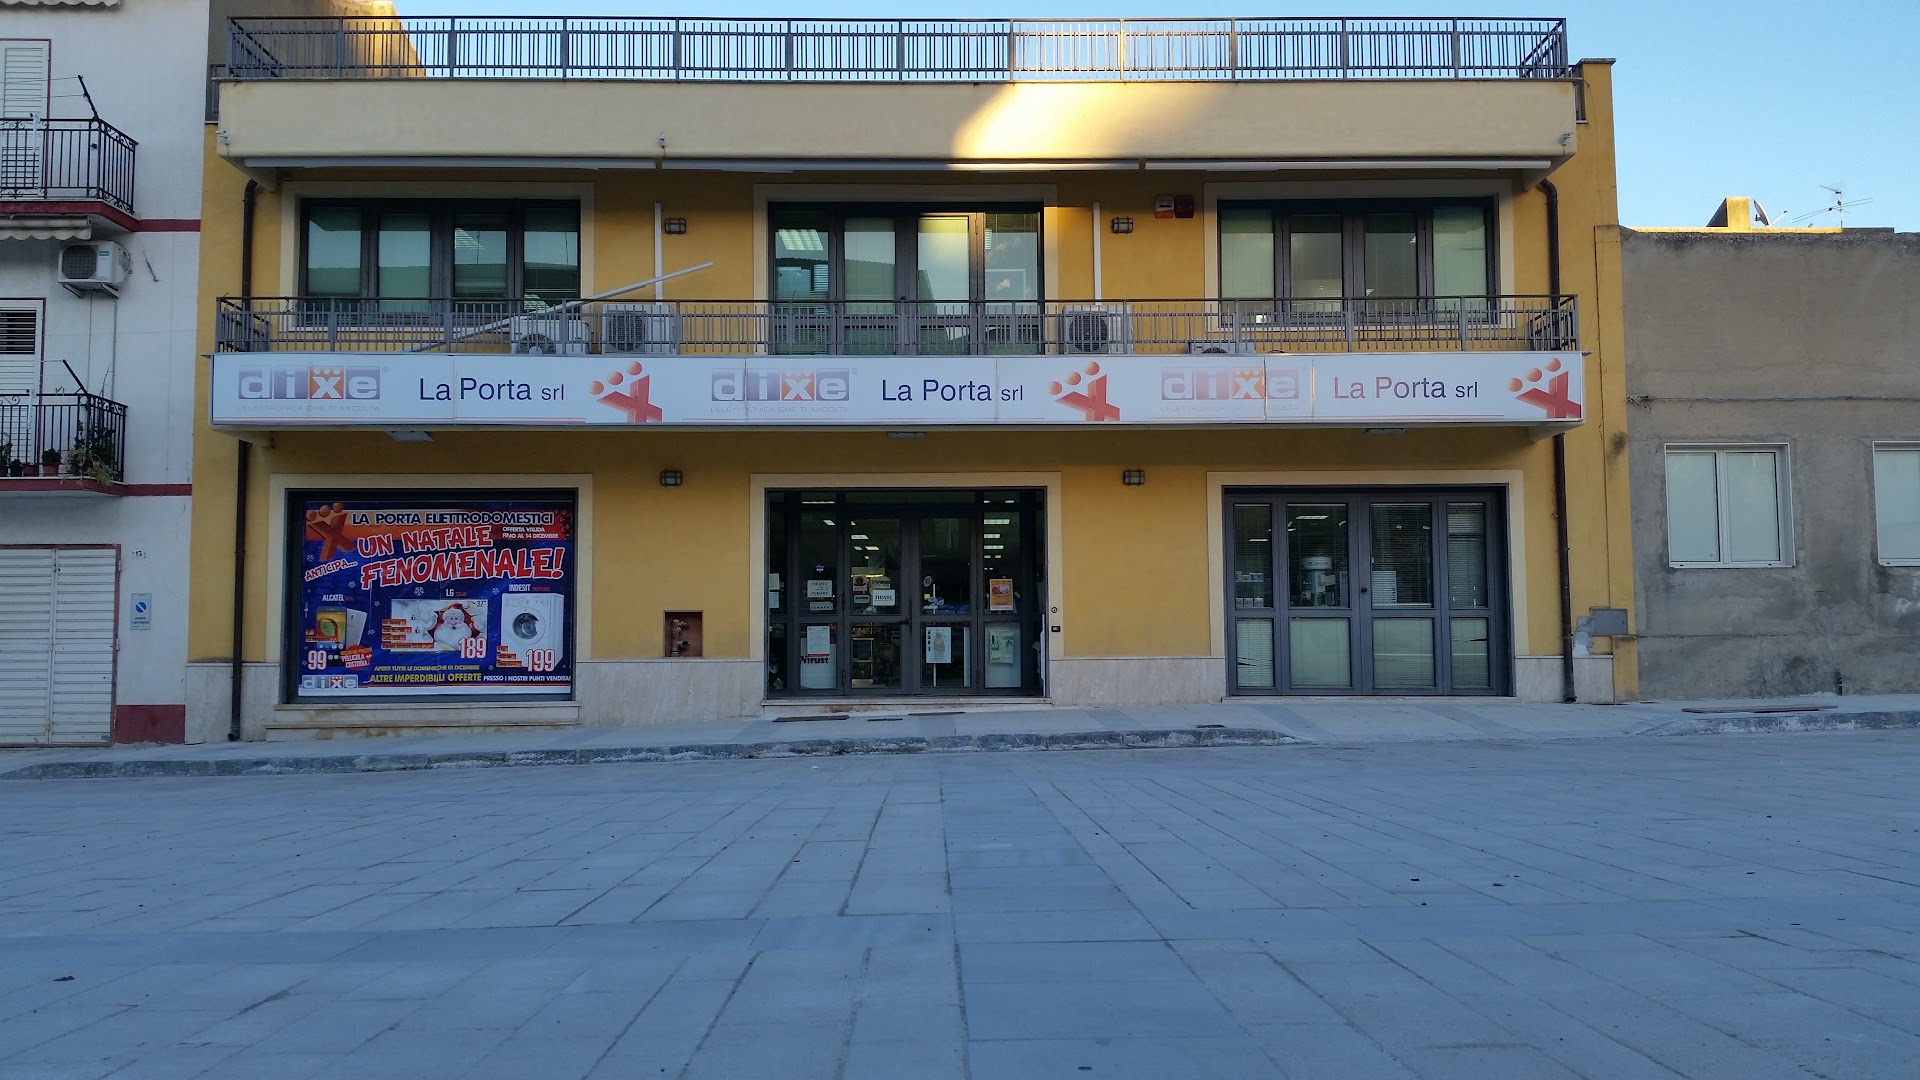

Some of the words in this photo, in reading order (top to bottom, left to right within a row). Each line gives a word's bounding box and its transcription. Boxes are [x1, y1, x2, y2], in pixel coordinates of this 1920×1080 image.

[240, 367, 378, 399] dixe
[419, 377, 452, 401] La
[460, 377, 532, 401] Porta
[540, 384, 565, 401] srl
[713, 368, 848, 400] dixe
[882, 379, 913, 401] La
[923, 379, 992, 401] Porta
[1000, 385, 1023, 401] srl
[1162, 367, 1297, 399] dixe
[1333, 376, 1366, 399] La
[1375, 376, 1447, 399] Porta
[1454, 381, 1478, 398] srl
[352, 512, 370, 525] LA
[375, 512, 422, 525] PORTA
[425, 511, 554, 525] ELETTRODOMESTICI
[357, 533, 395, 559] UN
[401, 525, 494, 554] NATALE
[361, 547, 566, 590] FENOMENALE!
[322, 593, 345, 602] ALCATEL
[445, 588, 455, 597] LG
[508, 583, 531, 592] INDESIT
[458, 637, 487, 659] 189
[307, 650, 327, 670] 99
[526, 648, 556, 672] 199
[303, 676, 357, 689] dixe
[447, 672, 482, 682] OFFERTE
